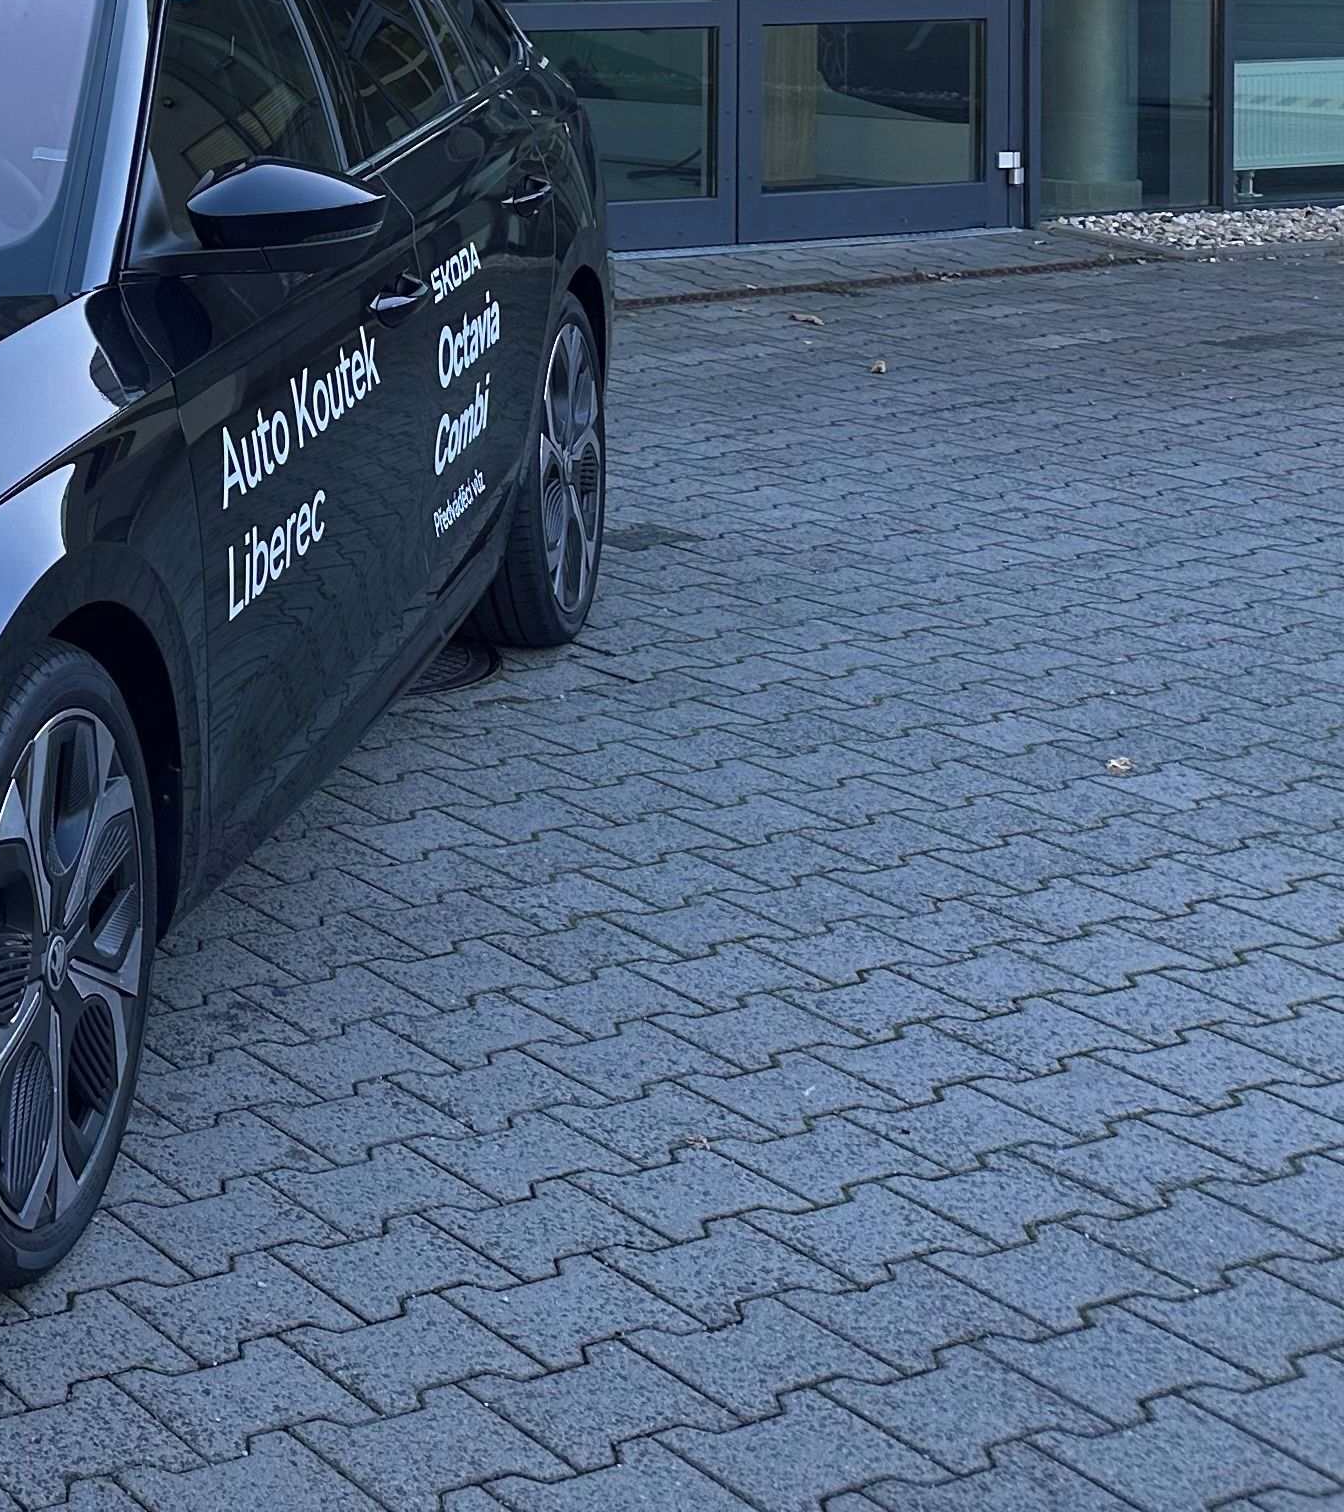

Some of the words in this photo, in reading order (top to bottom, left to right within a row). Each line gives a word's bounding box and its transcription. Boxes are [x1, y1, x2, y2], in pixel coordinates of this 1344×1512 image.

[438, 290, 501, 388] Octavia
[222, 407, 291, 510] Auto
[289, 325, 381, 448] Koutek
[434, 372, 491, 476] Combi
[228, 489, 327, 622] Liberec
